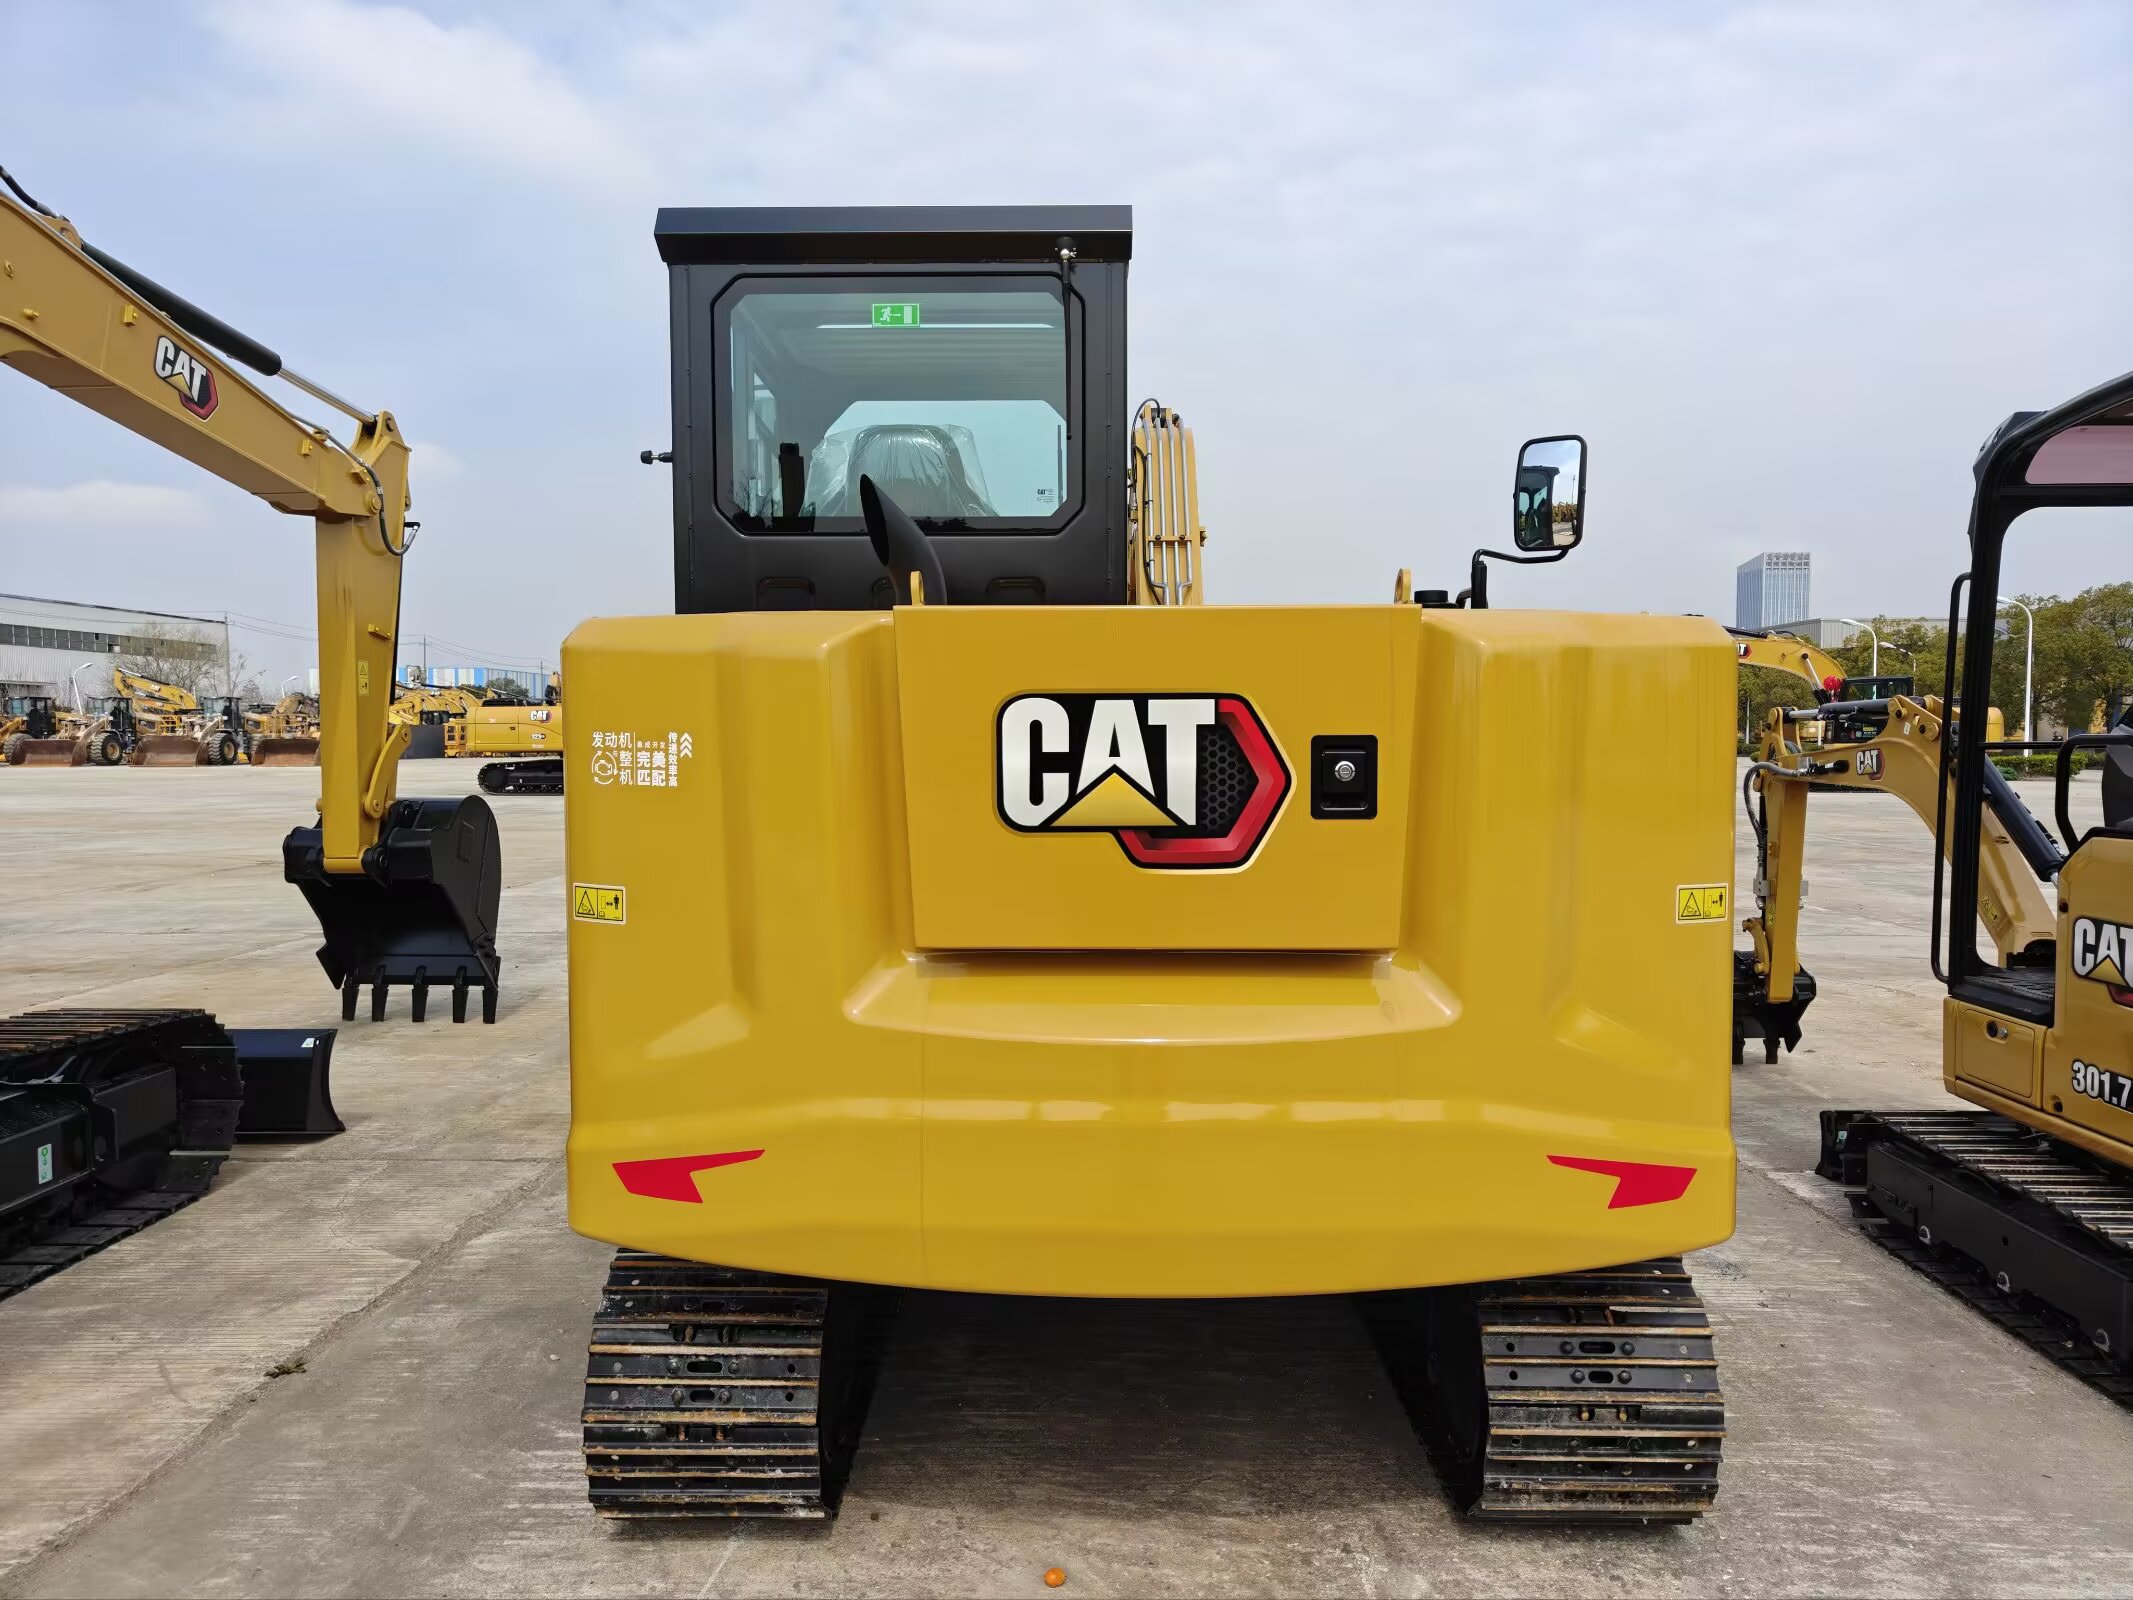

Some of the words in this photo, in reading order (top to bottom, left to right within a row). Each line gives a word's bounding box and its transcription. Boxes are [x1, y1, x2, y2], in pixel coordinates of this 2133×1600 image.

[155, 336, 207, 402] CAT
[530, 710, 549, 721] CAT
[592, 731, 633, 749] 发动机
[637, 750, 667, 768] 完美
[1001, 697, 1216, 827] CAT
[1857, 749, 1879, 775] CAT
[637, 769, 667, 787] 匹配
[2072, 1061, 2132, 1108] 301.7
